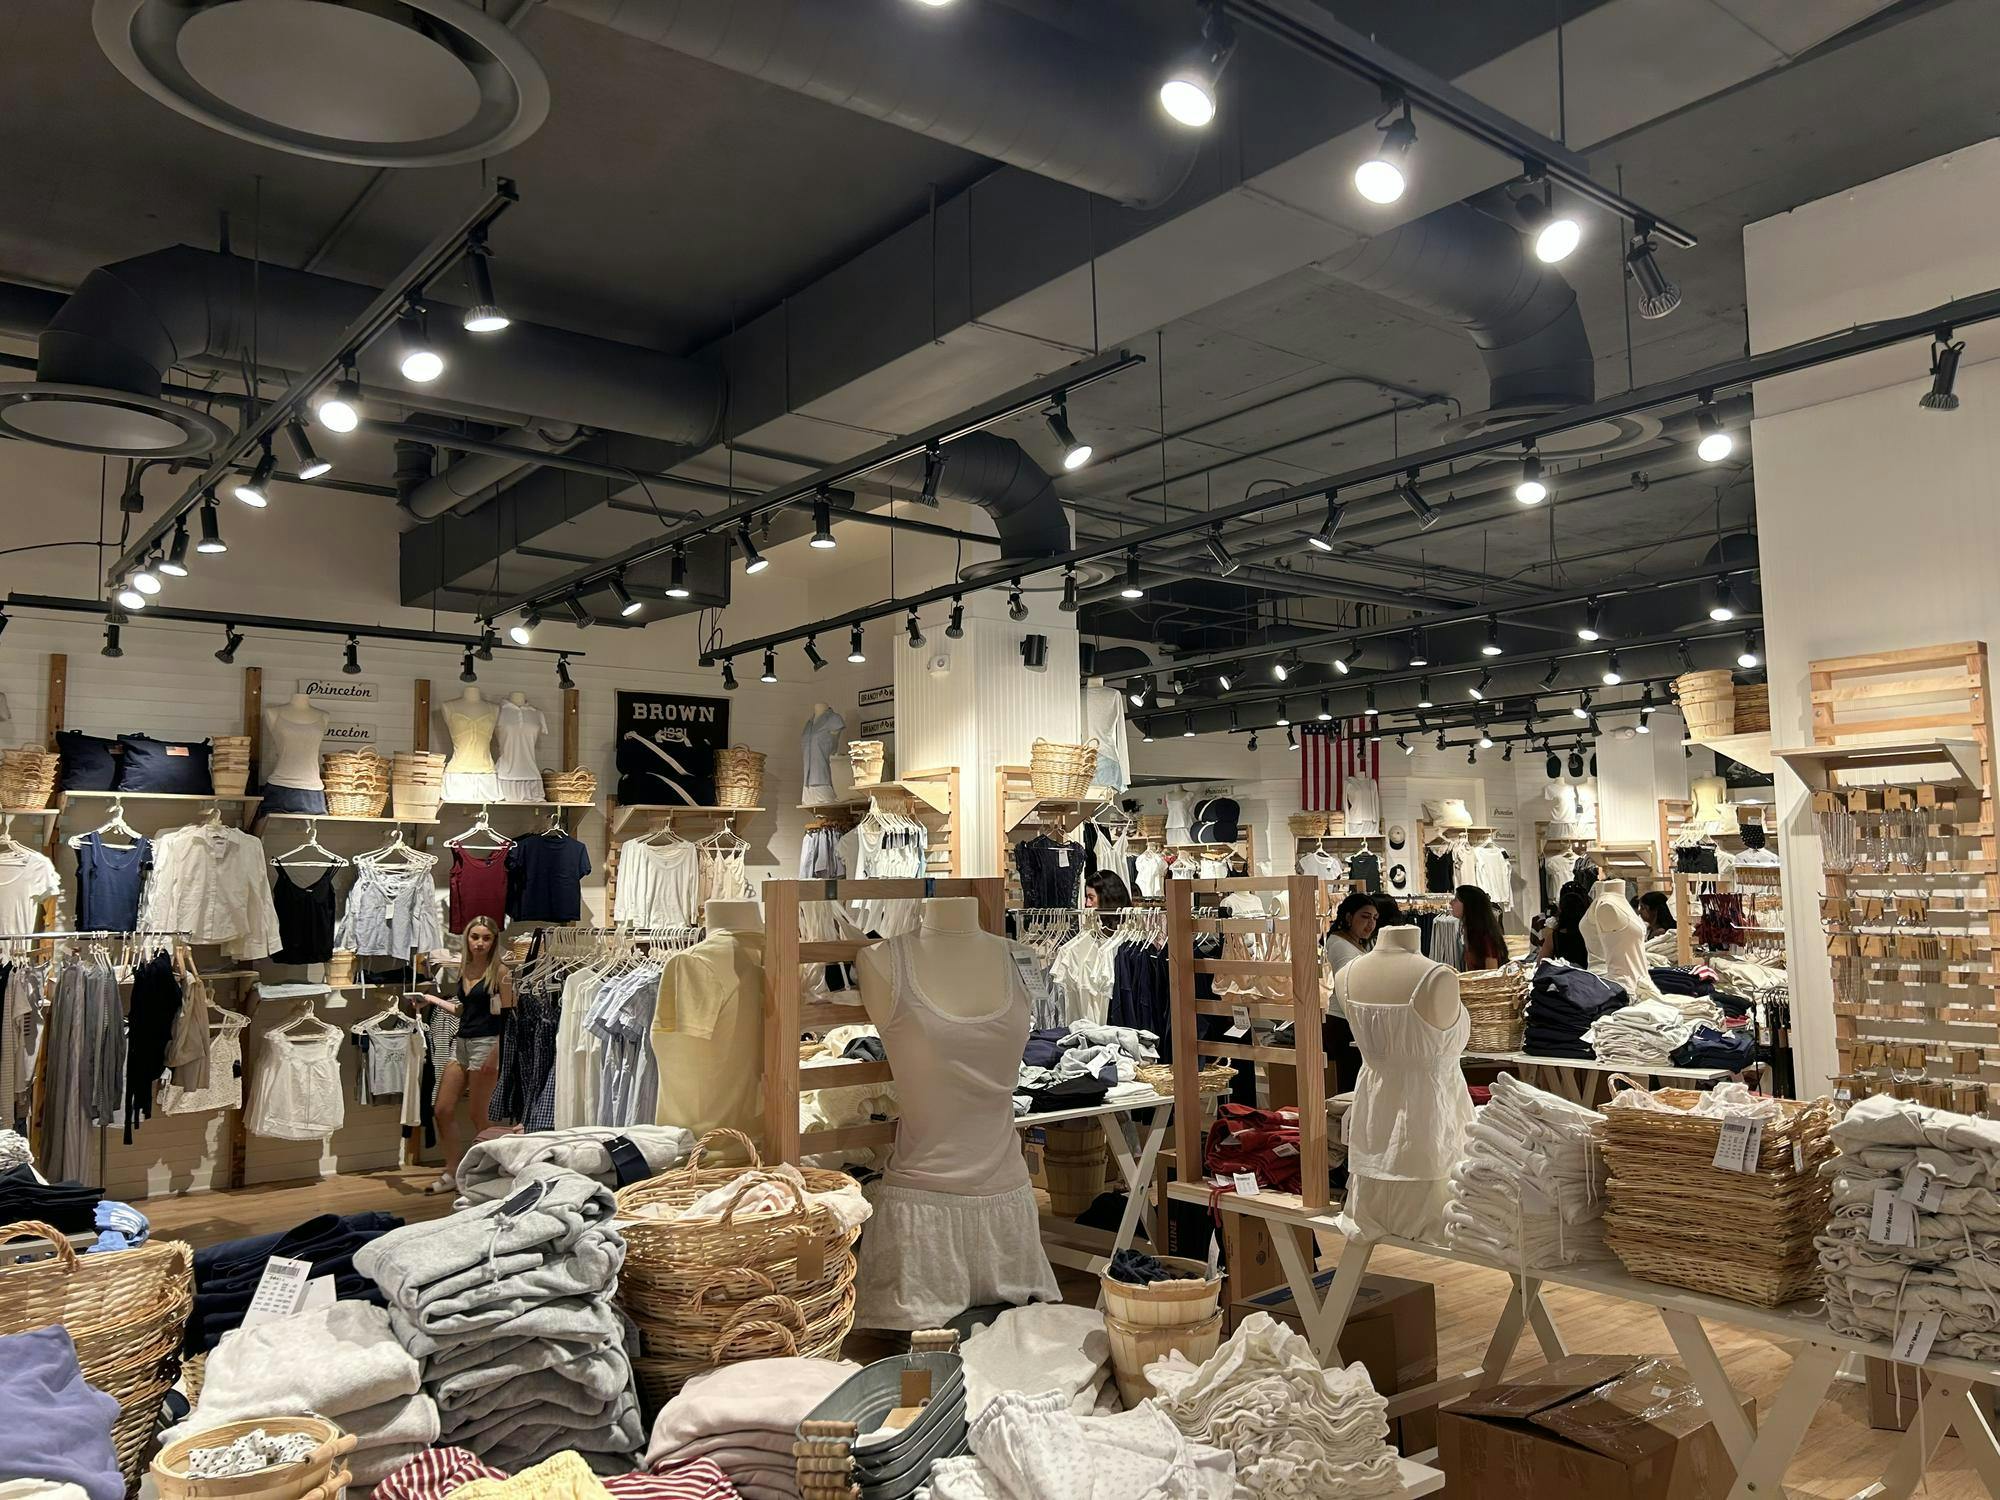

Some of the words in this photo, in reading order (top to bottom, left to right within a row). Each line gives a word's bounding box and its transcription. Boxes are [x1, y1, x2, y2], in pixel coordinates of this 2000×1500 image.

[305, 682, 372, 697] Princeton
[632, 702, 715, 723] BROWN
[325, 726, 370, 739] nceton
[1916, 1176, 1931, 1204] Small/Me
[1169, 1219, 1178, 1252] ULINE
[1883, 1203, 1894, 1241] Small/Medium
[1904, 1321, 1923, 1358] Small/Medium
